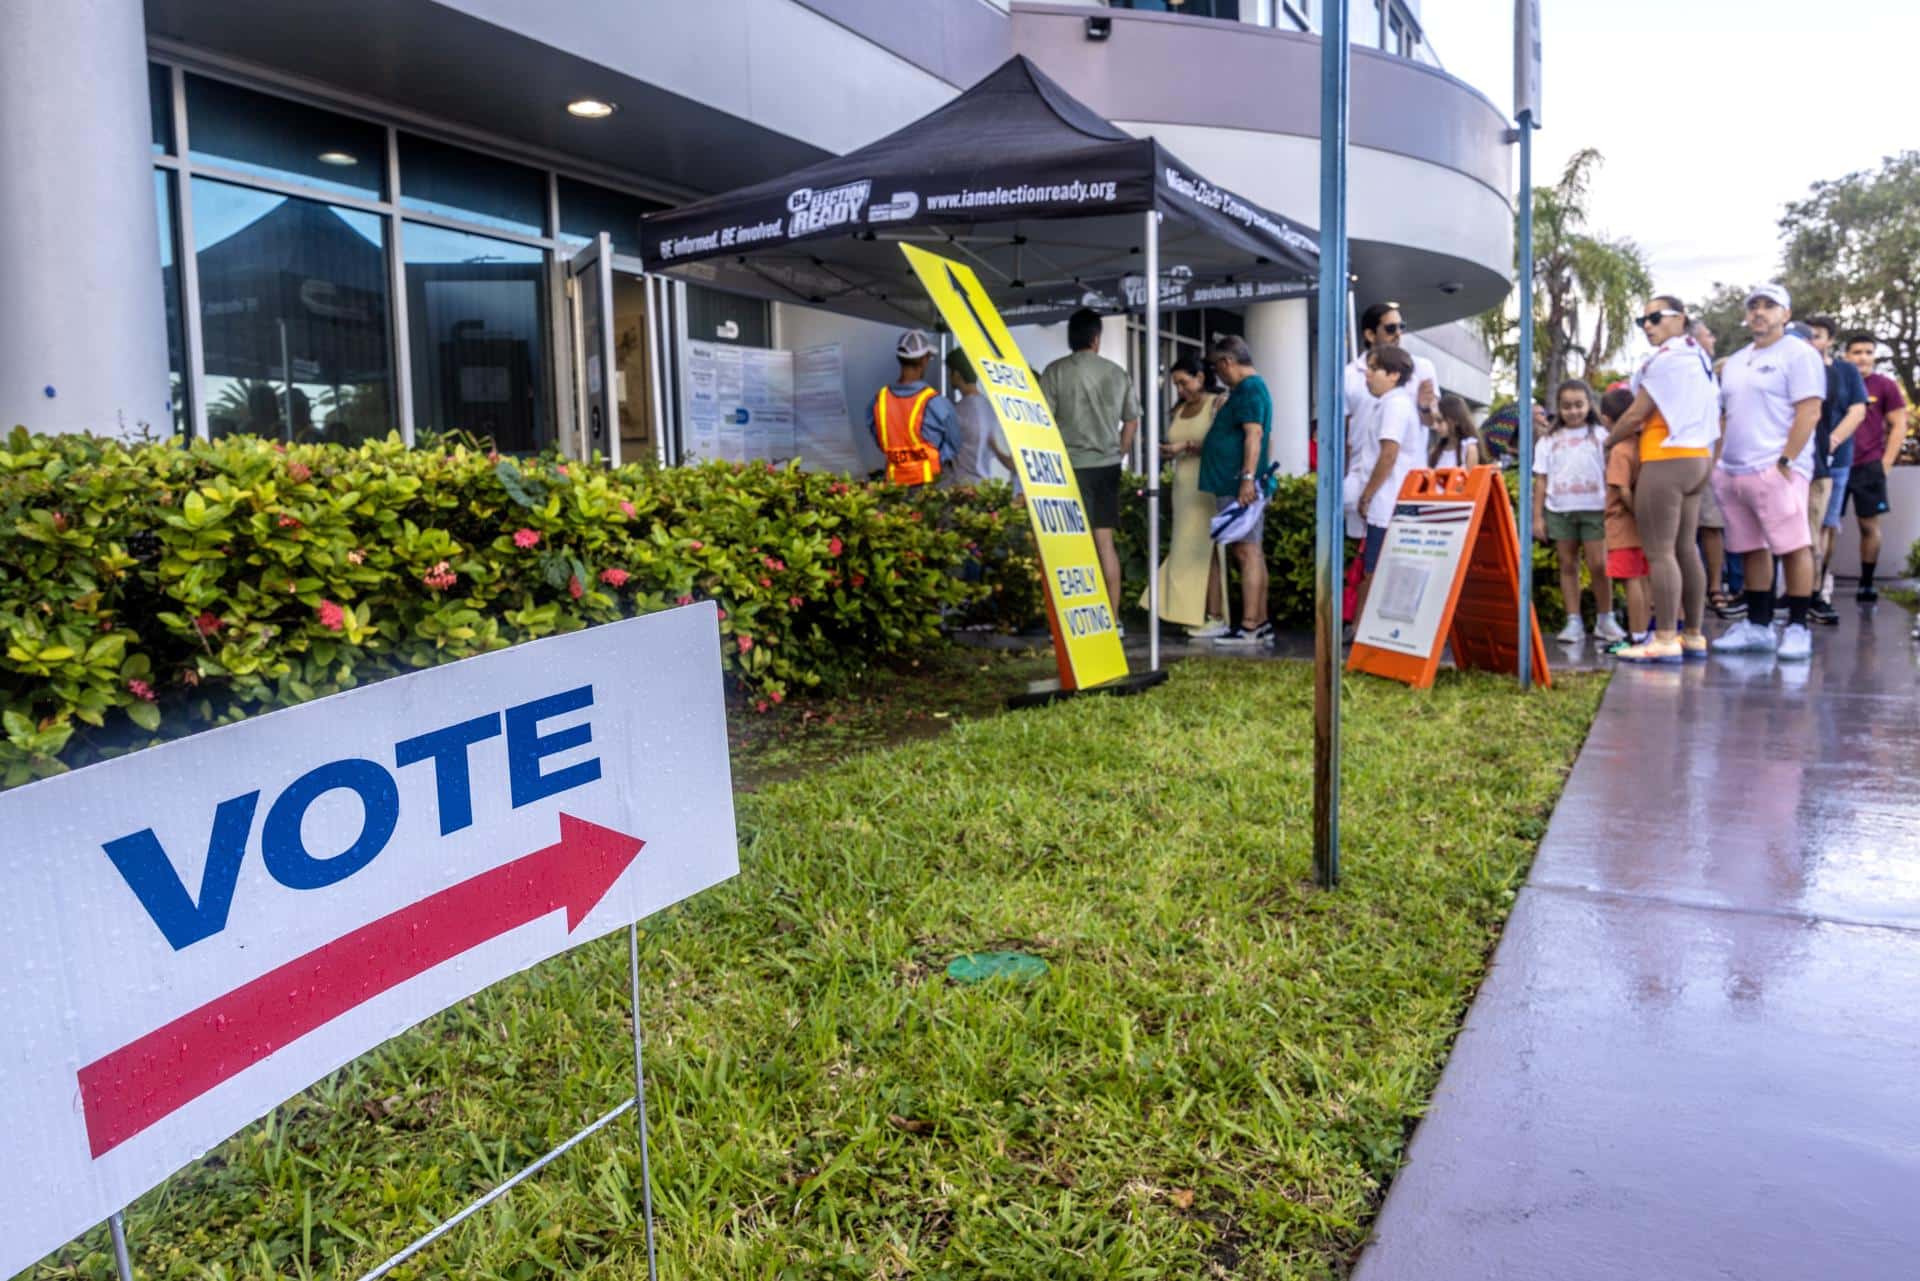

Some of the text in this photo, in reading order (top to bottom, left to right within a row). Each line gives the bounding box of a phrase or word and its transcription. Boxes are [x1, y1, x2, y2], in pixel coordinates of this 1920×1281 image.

[926, 180, 1117, 210] www.iamelectionready.org
[791, 198, 864, 231] READY
[660, 218, 783, 259] BE informed. BE involved.
[981, 359, 1028, 391] EARLY
[995, 395, 1052, 428] VOTING
[1021, 448, 1067, 485] EARLY
[1031, 498, 1086, 533] VOTING
[1057, 568, 1097, 596] EARLY
[1064, 604, 1111, 636] VOTING
[102, 685, 602, 951] VOTE
